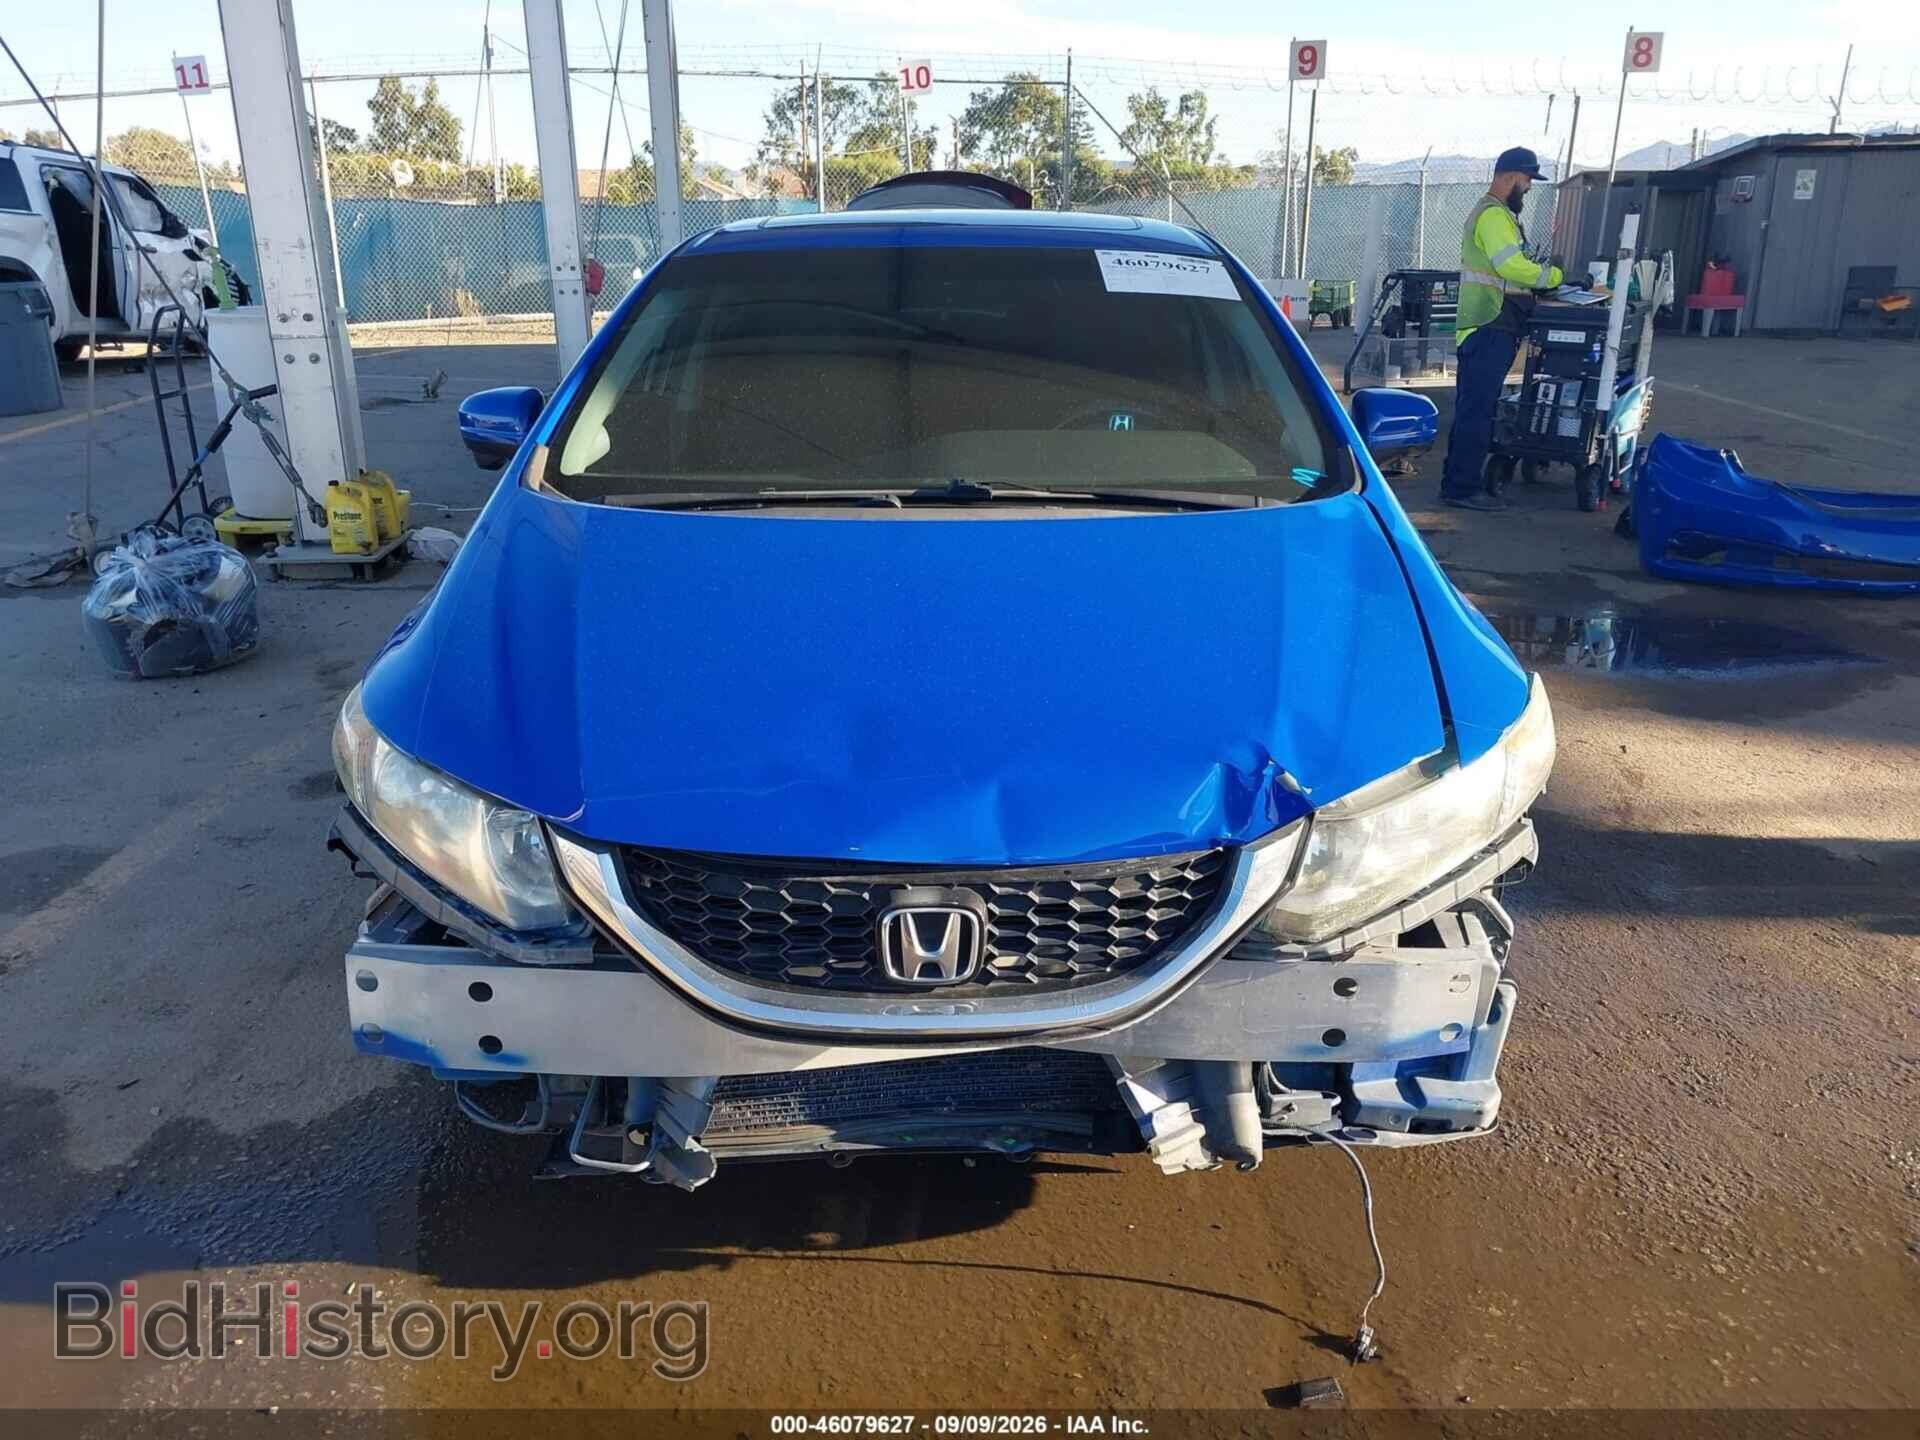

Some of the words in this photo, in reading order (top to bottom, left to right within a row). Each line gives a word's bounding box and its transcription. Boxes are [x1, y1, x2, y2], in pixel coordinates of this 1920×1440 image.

[1298, 45, 1317, 76] 9
[1632, 36, 1653, 68] 8
[176, 63, 209, 89] 11
[900, 66, 930, 89] 10
[1111, 258, 1210, 274] 46079627
